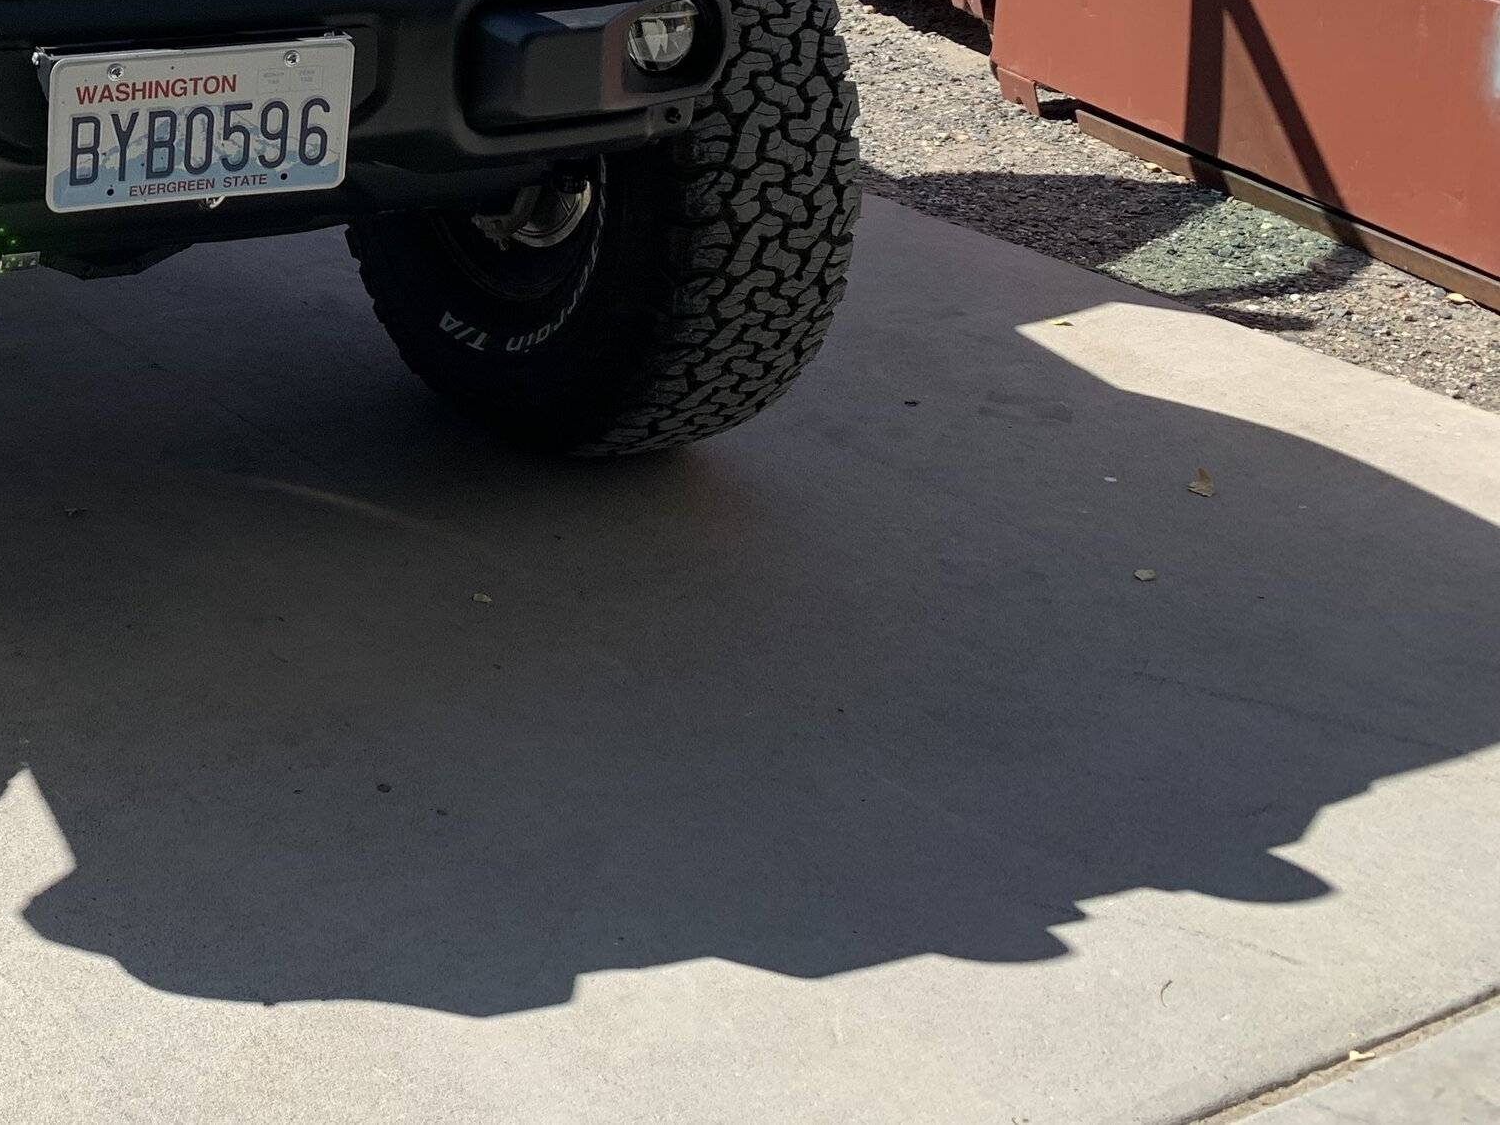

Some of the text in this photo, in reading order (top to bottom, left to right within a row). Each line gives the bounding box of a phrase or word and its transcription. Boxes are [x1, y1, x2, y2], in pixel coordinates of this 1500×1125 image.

[76, 74, 237, 105] WASHINGTON
[69, 97, 331, 186] BYB0596
[129, 174, 268, 197] EVERGREEN STATE
